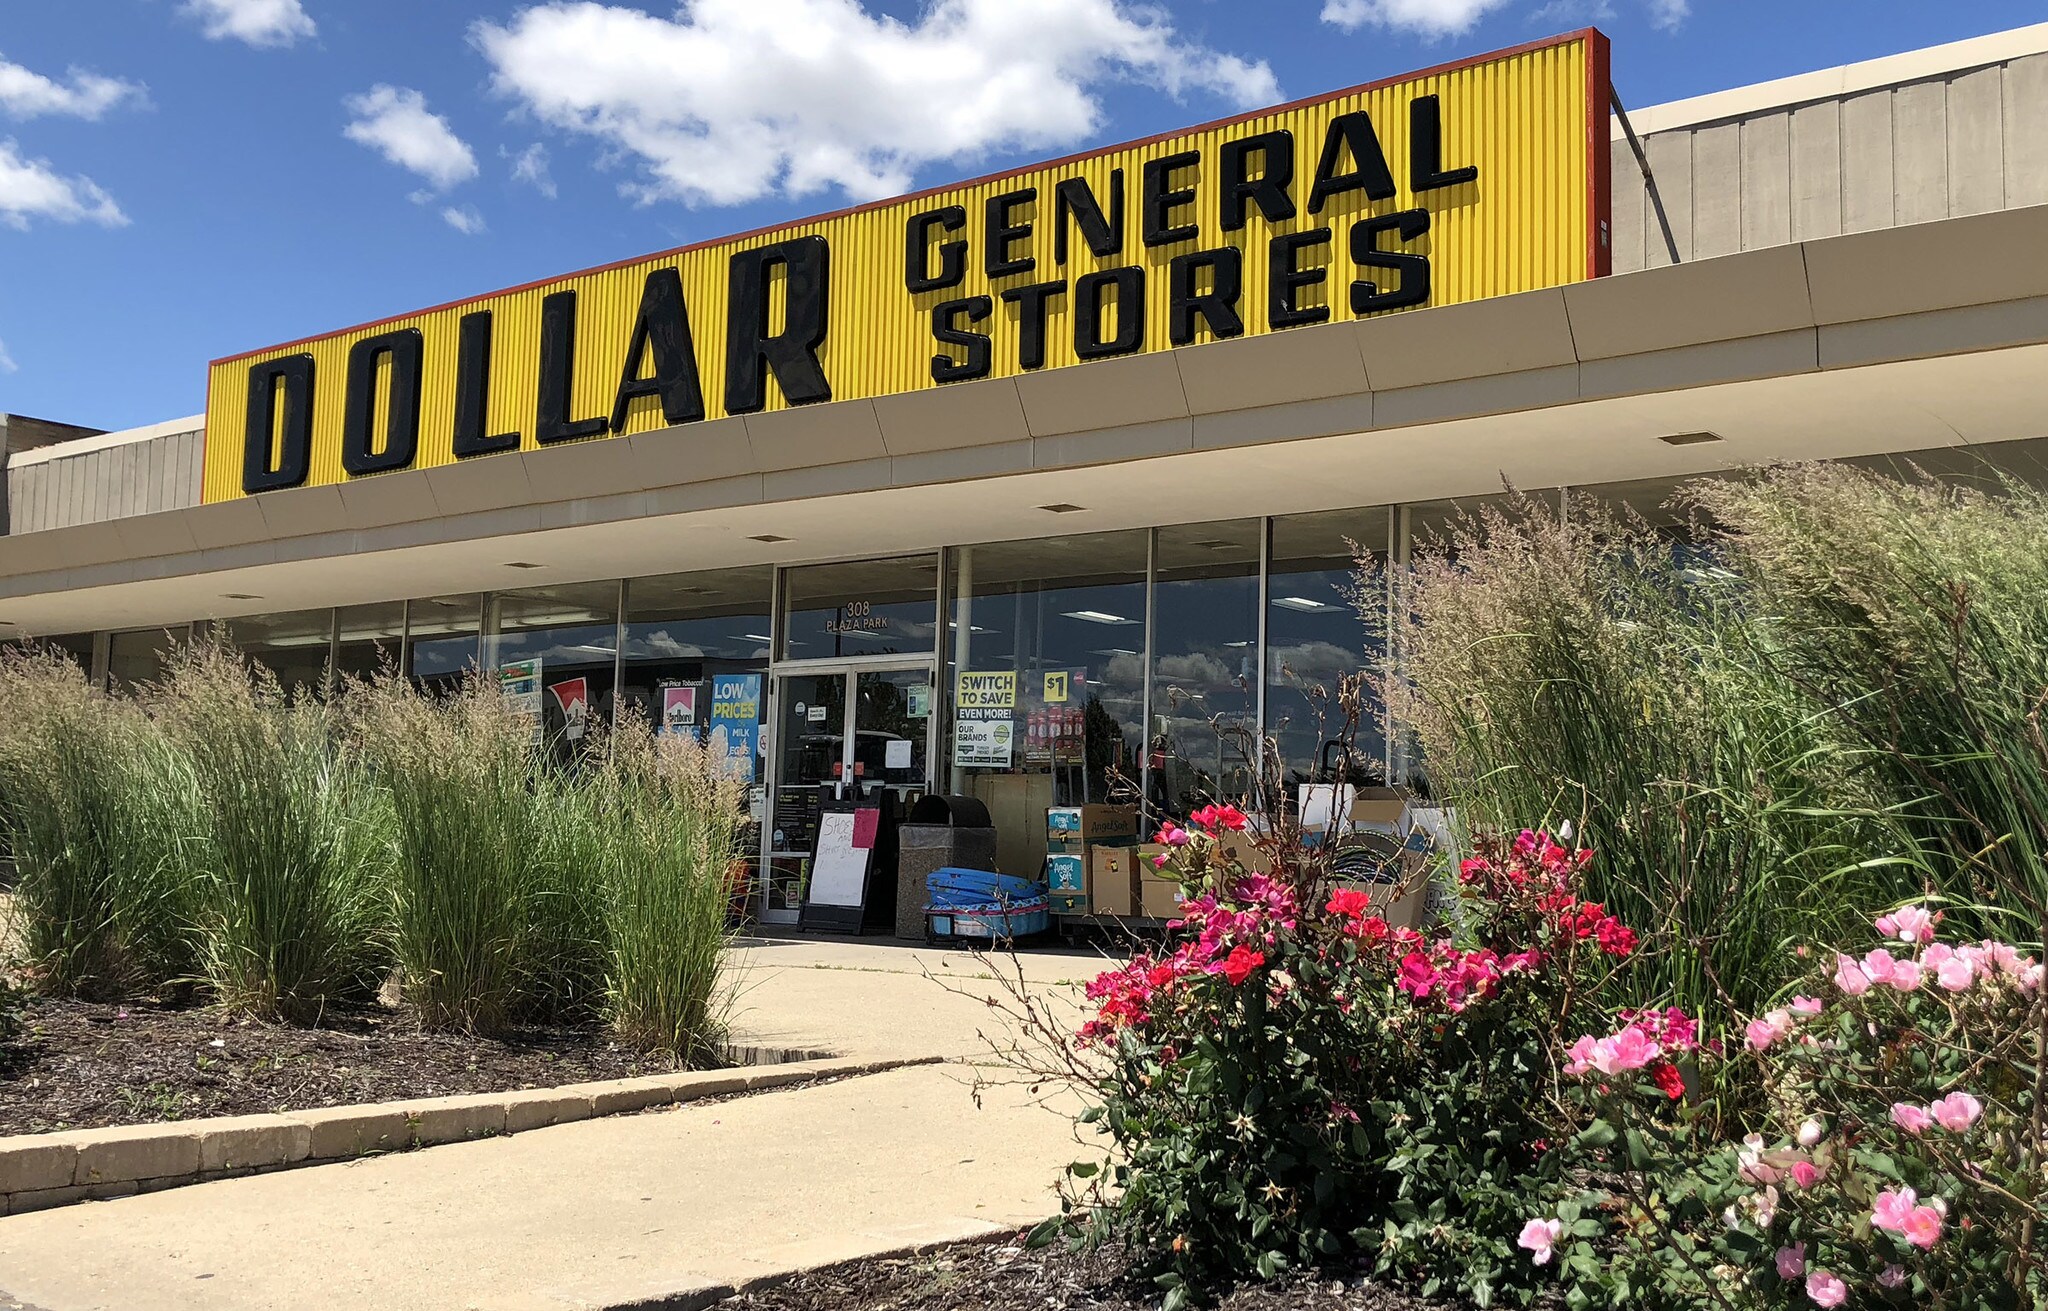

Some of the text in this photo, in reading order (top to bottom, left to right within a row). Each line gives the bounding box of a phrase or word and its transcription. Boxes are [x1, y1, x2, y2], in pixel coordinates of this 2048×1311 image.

[906, 94, 1478, 293] GENERAL
[931, 208, 1431, 383] STORES
[242, 234, 832, 494] DOLLAR
[847, 601, 870, 617] 308
[826, 617, 888, 632] PLAZA PARK
[961, 676, 1013, 690] SWITCH
[1047, 676, 1064, 697] $1
[714, 683, 745, 699] LOW
[961, 692, 1012, 704] TO SAVE
[713, 702, 756, 719] PRICES
[959, 708, 1012, 719] EVEN MORE!
[732, 728, 750, 737] MILK
[958, 725, 974, 733] OUR
[958, 733, 987, 742] BRANDS
[1054, 815, 1069, 824] Angel
[1091, 820, 1128, 833] Angel Soft
[1054, 862, 1074, 873] Angel
[1059, 871, 1073, 882] Soft
